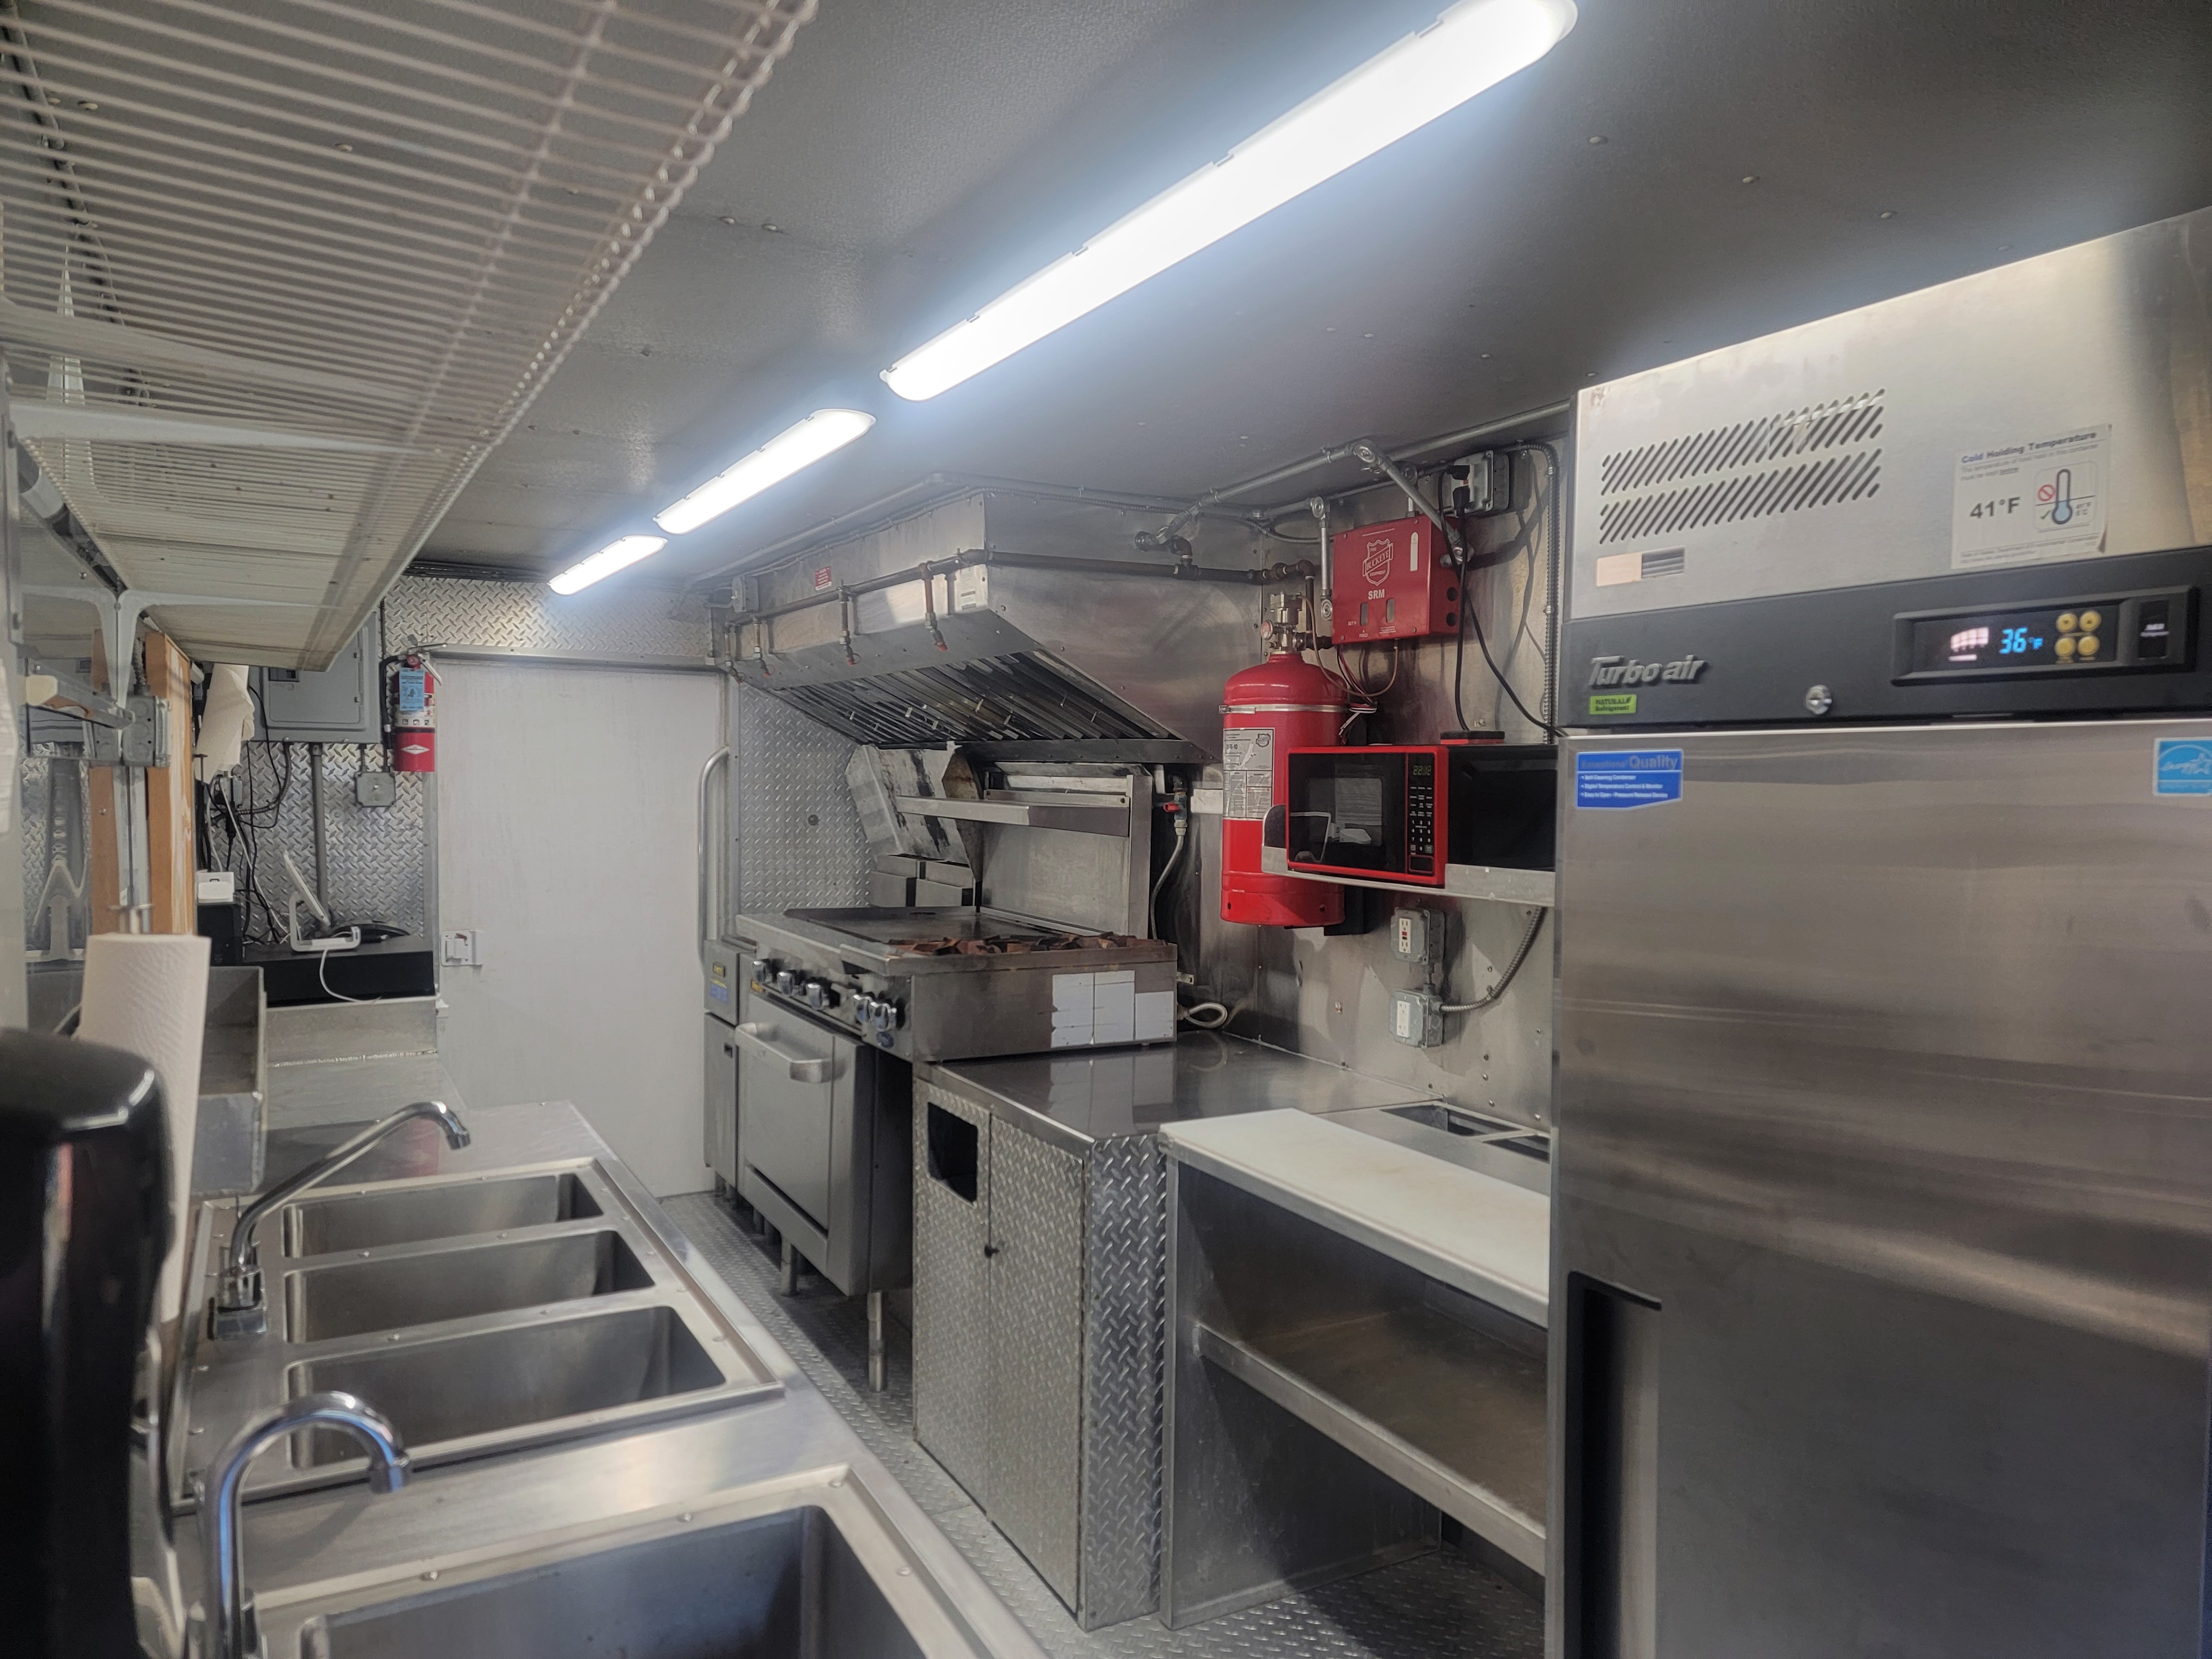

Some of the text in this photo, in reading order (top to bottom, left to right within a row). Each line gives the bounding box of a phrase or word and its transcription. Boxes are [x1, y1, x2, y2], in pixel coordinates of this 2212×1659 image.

[1961, 432, 2097, 463] Cold Holding Temperature
[1970, 496, 2021, 519] 41°F
[1366, 549, 1389, 571] BUCKEYE
[1368, 588, 1385, 600] SRM
[1588, 654, 1706, 687] Turbo air
[1628, 755, 1678, 770] Quality
